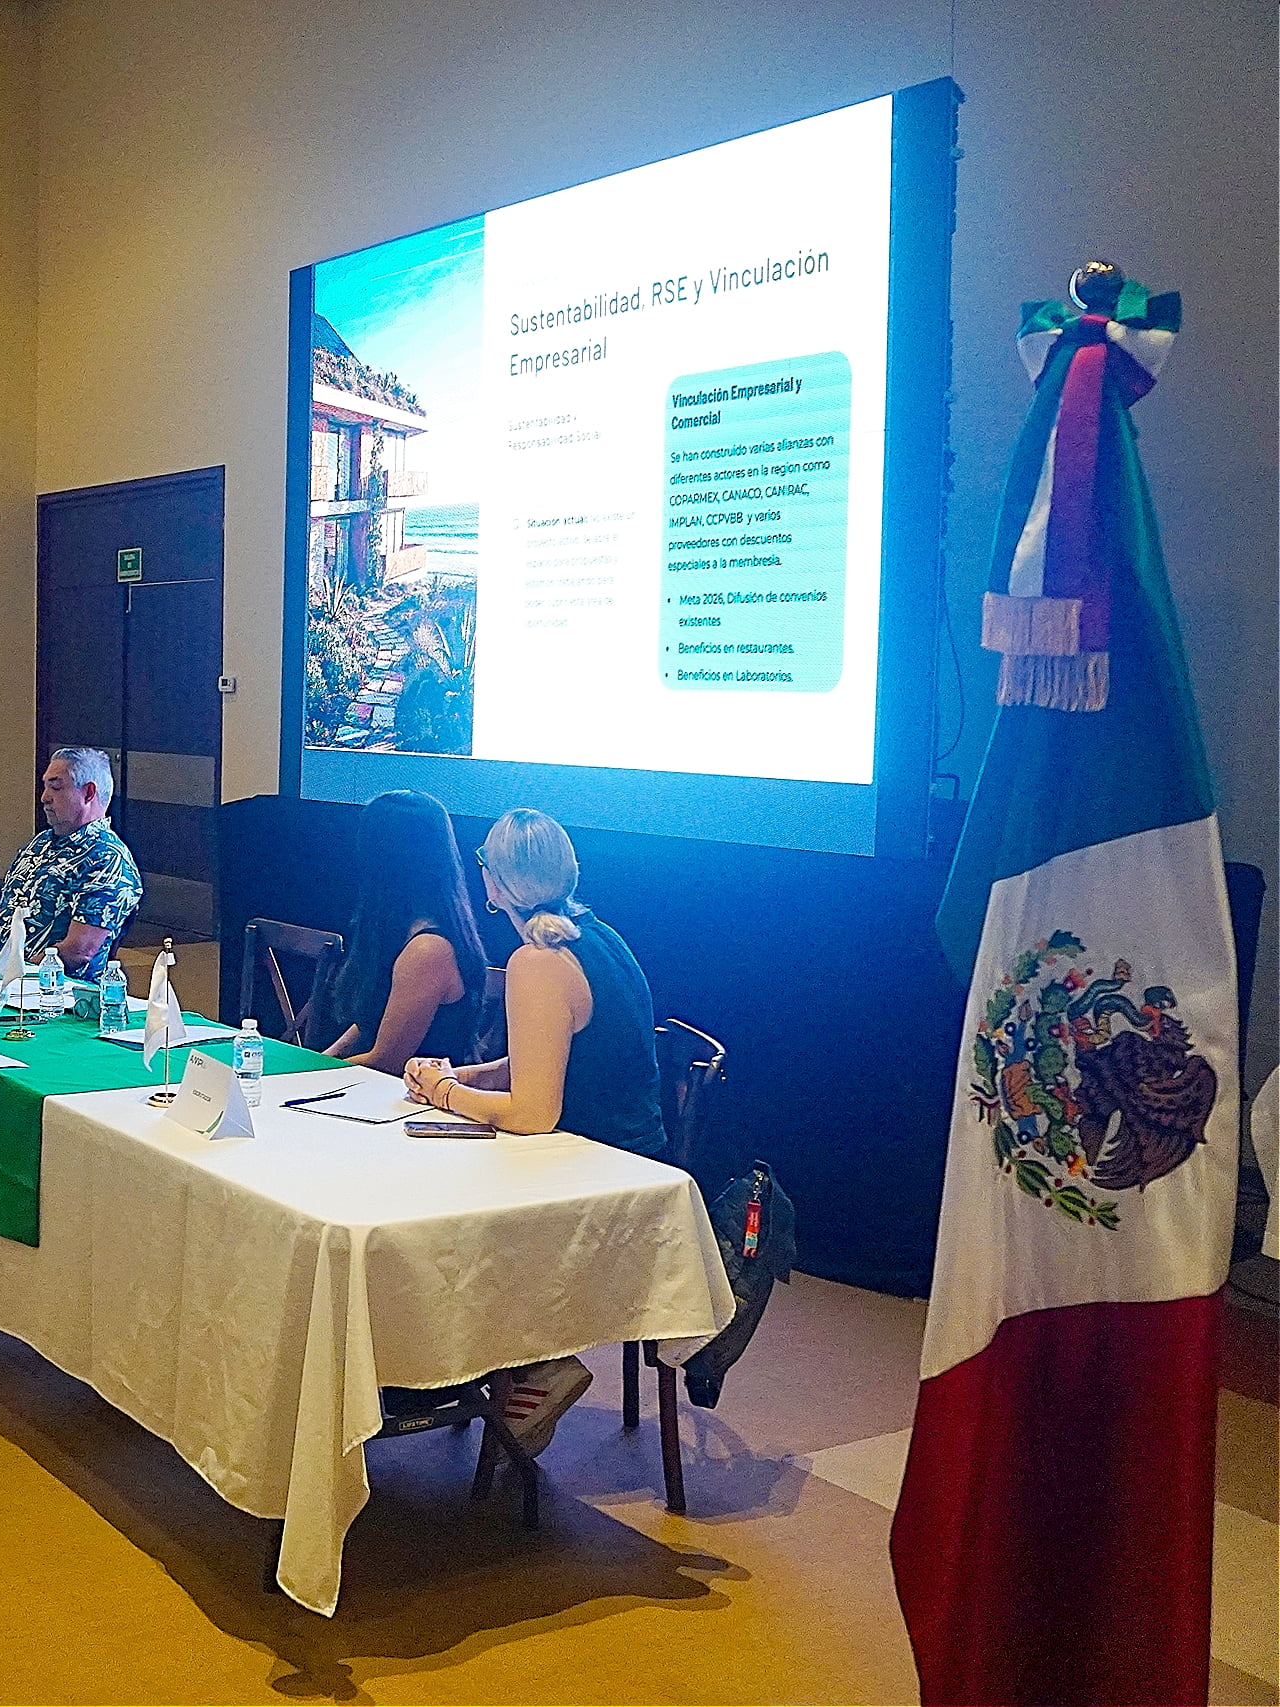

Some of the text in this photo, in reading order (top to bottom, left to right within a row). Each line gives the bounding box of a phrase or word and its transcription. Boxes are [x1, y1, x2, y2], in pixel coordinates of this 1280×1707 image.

[511, 249, 829, 336] Sustentabilidad, RSE y Vinculación
[511, 338, 607, 377] Empresarial
[672, 377, 802, 408] Vinculación Empresarial y
[672, 411, 720, 430] Comercial
[671, 435, 834, 463] Se han construido varias alianzas con
[670, 469, 711, 485] diferentes
[714, 467, 745, 480] actores
[747, 467, 759, 476] en
[761, 465, 768, 475] la
[803, 460, 830, 471] como
[722, 488, 763, 501] CANACO,
[747, 513, 752, 525] y
[755, 509, 781, 521] varios
[669, 533, 792, 551] proveedores con descuentos
[668, 559, 710, 572] especiales
[713, 560, 717, 569] a
[720, 558, 727, 568] la
[680, 594, 701, 605] Meta
[703, 593, 725, 605] 2026,
[766, 591, 777, 602] de
[779, 590, 828, 602] convenios
[679, 616, 721, 627] existentes
[678, 642, 721, 654] Beneficios
[724, 645, 734, 653] en
[677, 669, 720, 680] Beneficios
